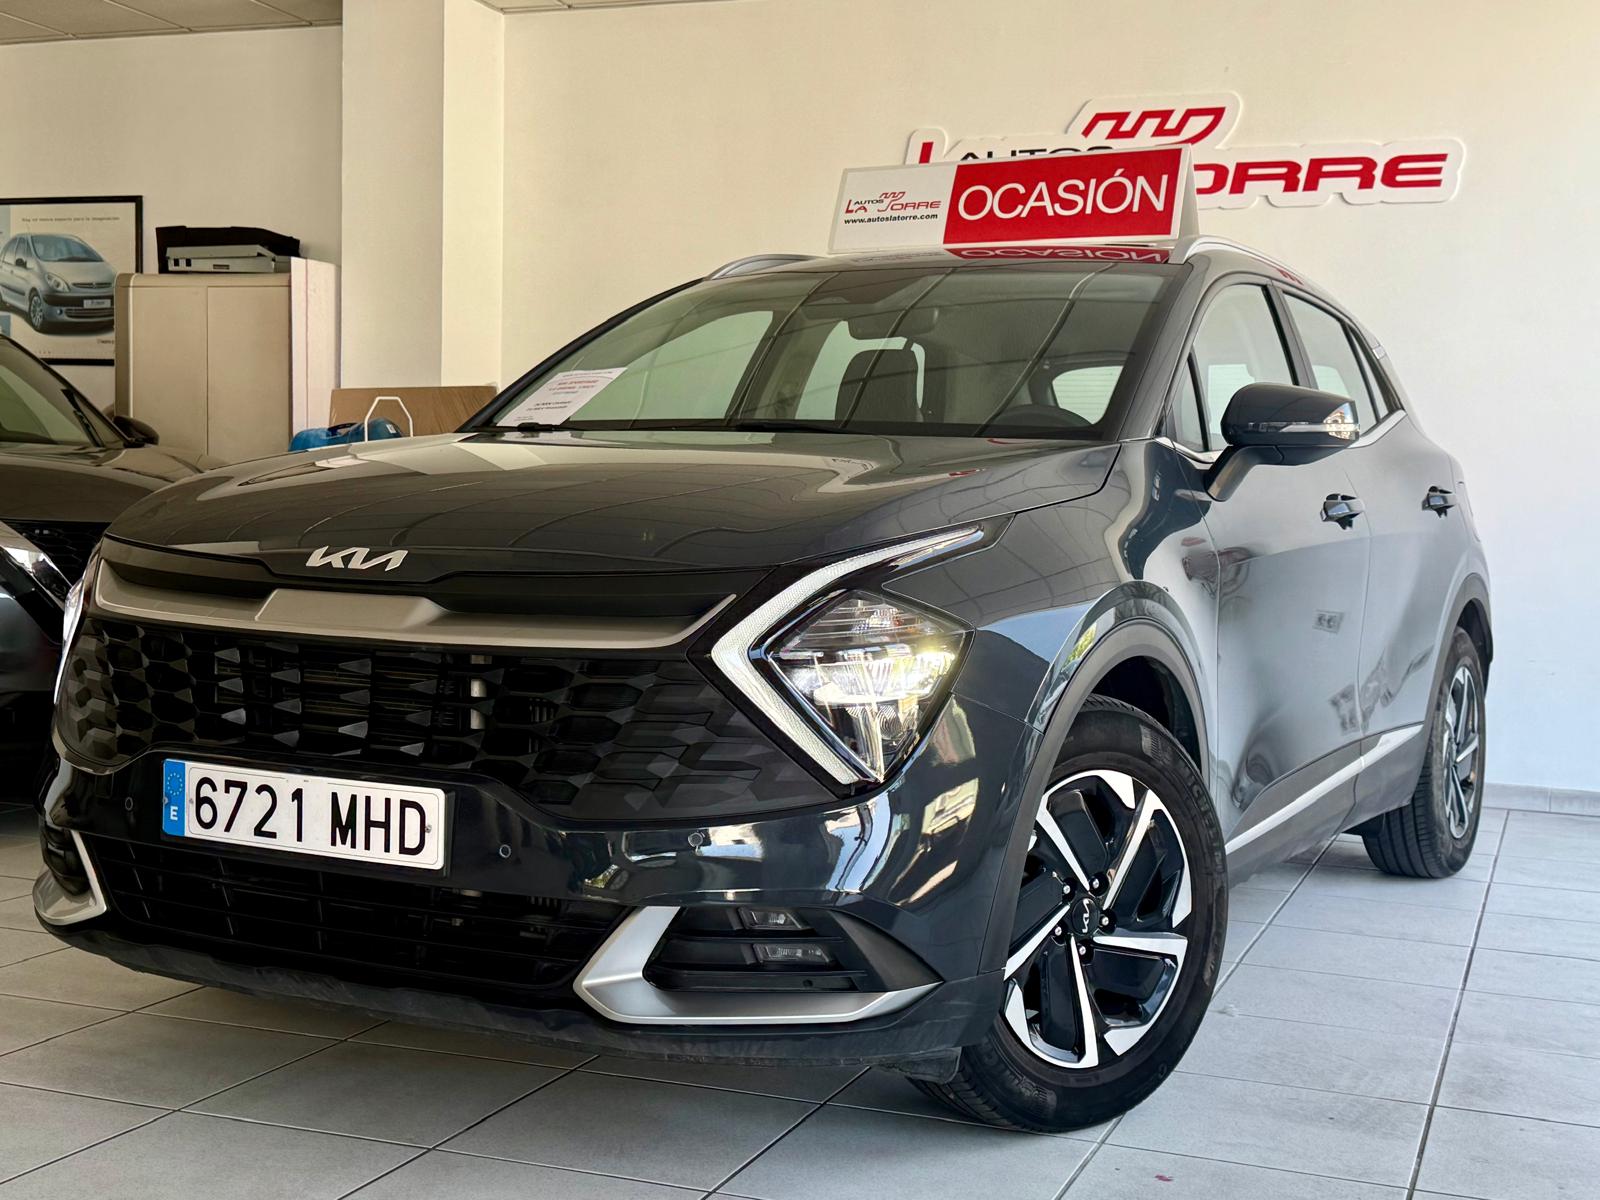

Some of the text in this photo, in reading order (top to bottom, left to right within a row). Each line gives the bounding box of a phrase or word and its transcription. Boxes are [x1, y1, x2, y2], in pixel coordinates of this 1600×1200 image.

[957, 168, 1169, 221] OCASIÓN
[844, 213, 938, 225] www.autoslatorre.com
[305, 545, 409, 572] KIA
[169, 805, 179, 821] E
[194, 776, 427, 856] 6721 MHD
